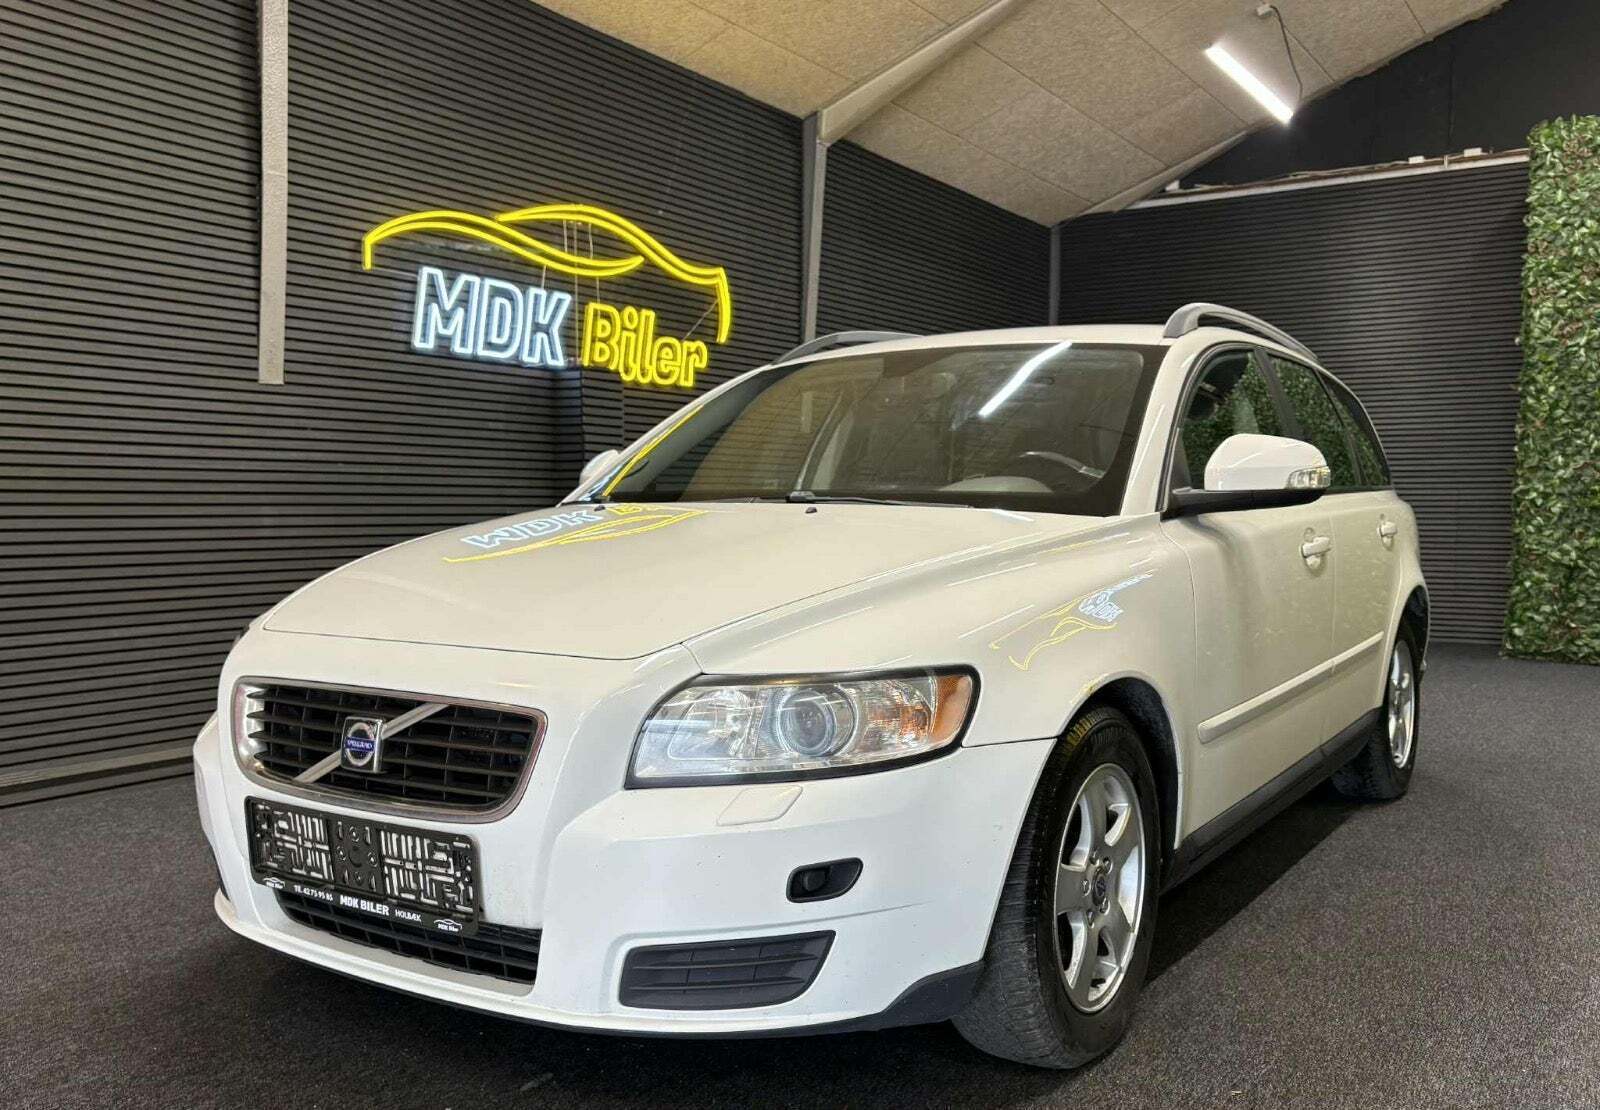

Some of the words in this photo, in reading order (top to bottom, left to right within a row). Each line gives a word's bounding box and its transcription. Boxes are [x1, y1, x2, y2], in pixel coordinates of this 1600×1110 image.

[412, 266, 572, 367] MDK
[582, 302, 708, 388] Biler
[340, 894, 359, 909] MDK
[360, 899, 390, 916] BILER
